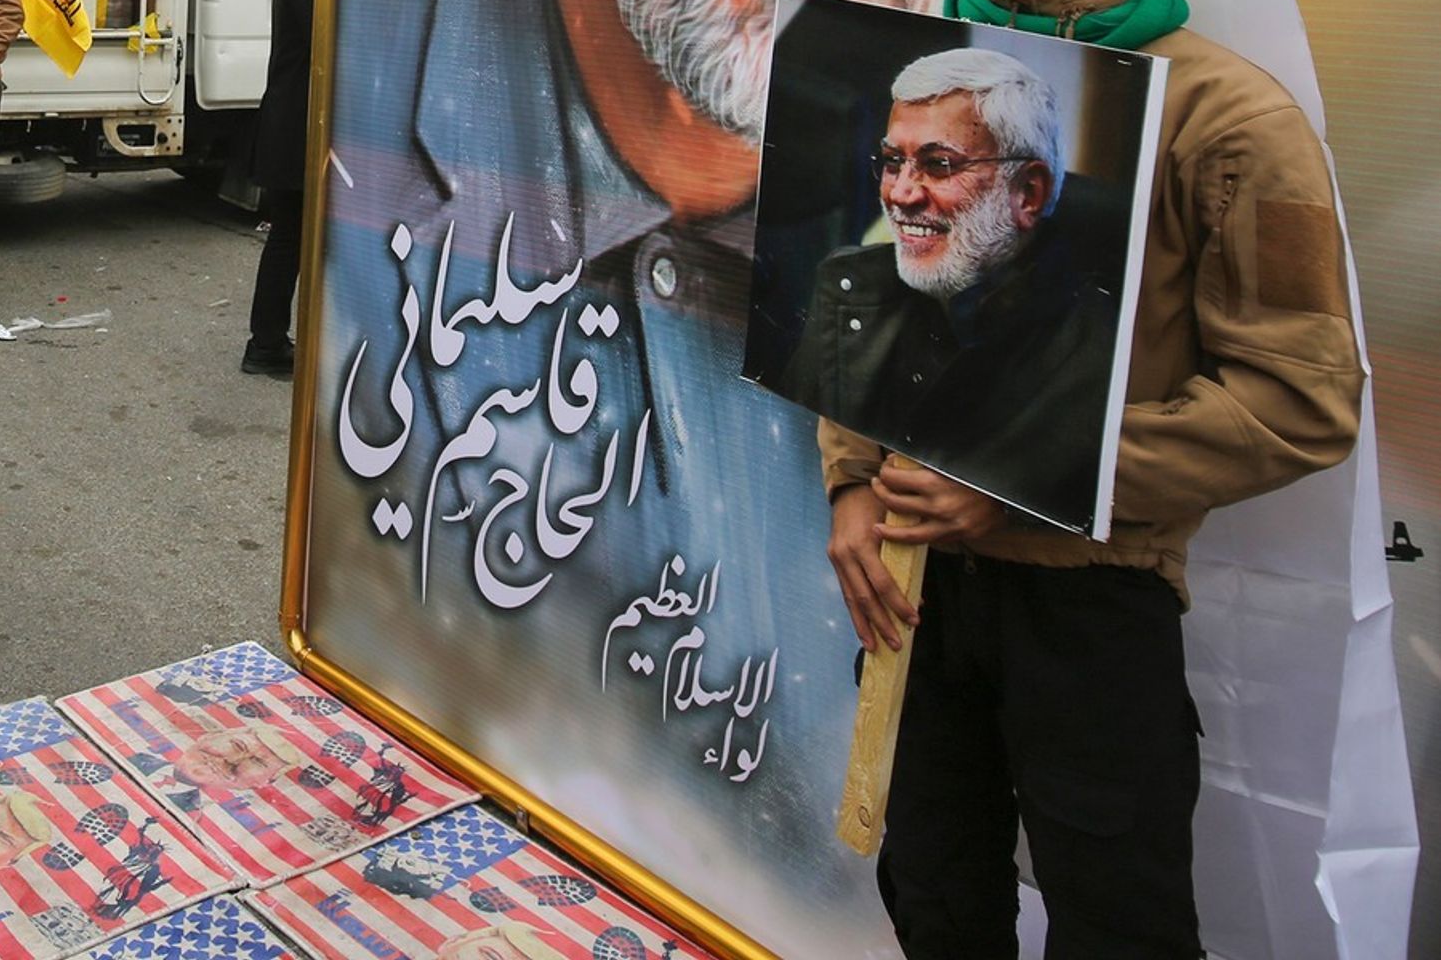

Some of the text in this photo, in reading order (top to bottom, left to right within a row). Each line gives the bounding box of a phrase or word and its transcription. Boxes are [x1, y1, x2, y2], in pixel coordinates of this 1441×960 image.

[339, 211, 652, 610] الحاج قاسم سليماني
[601, 553, 722, 695] العظيم
[702, 716, 771, 784] لواء
